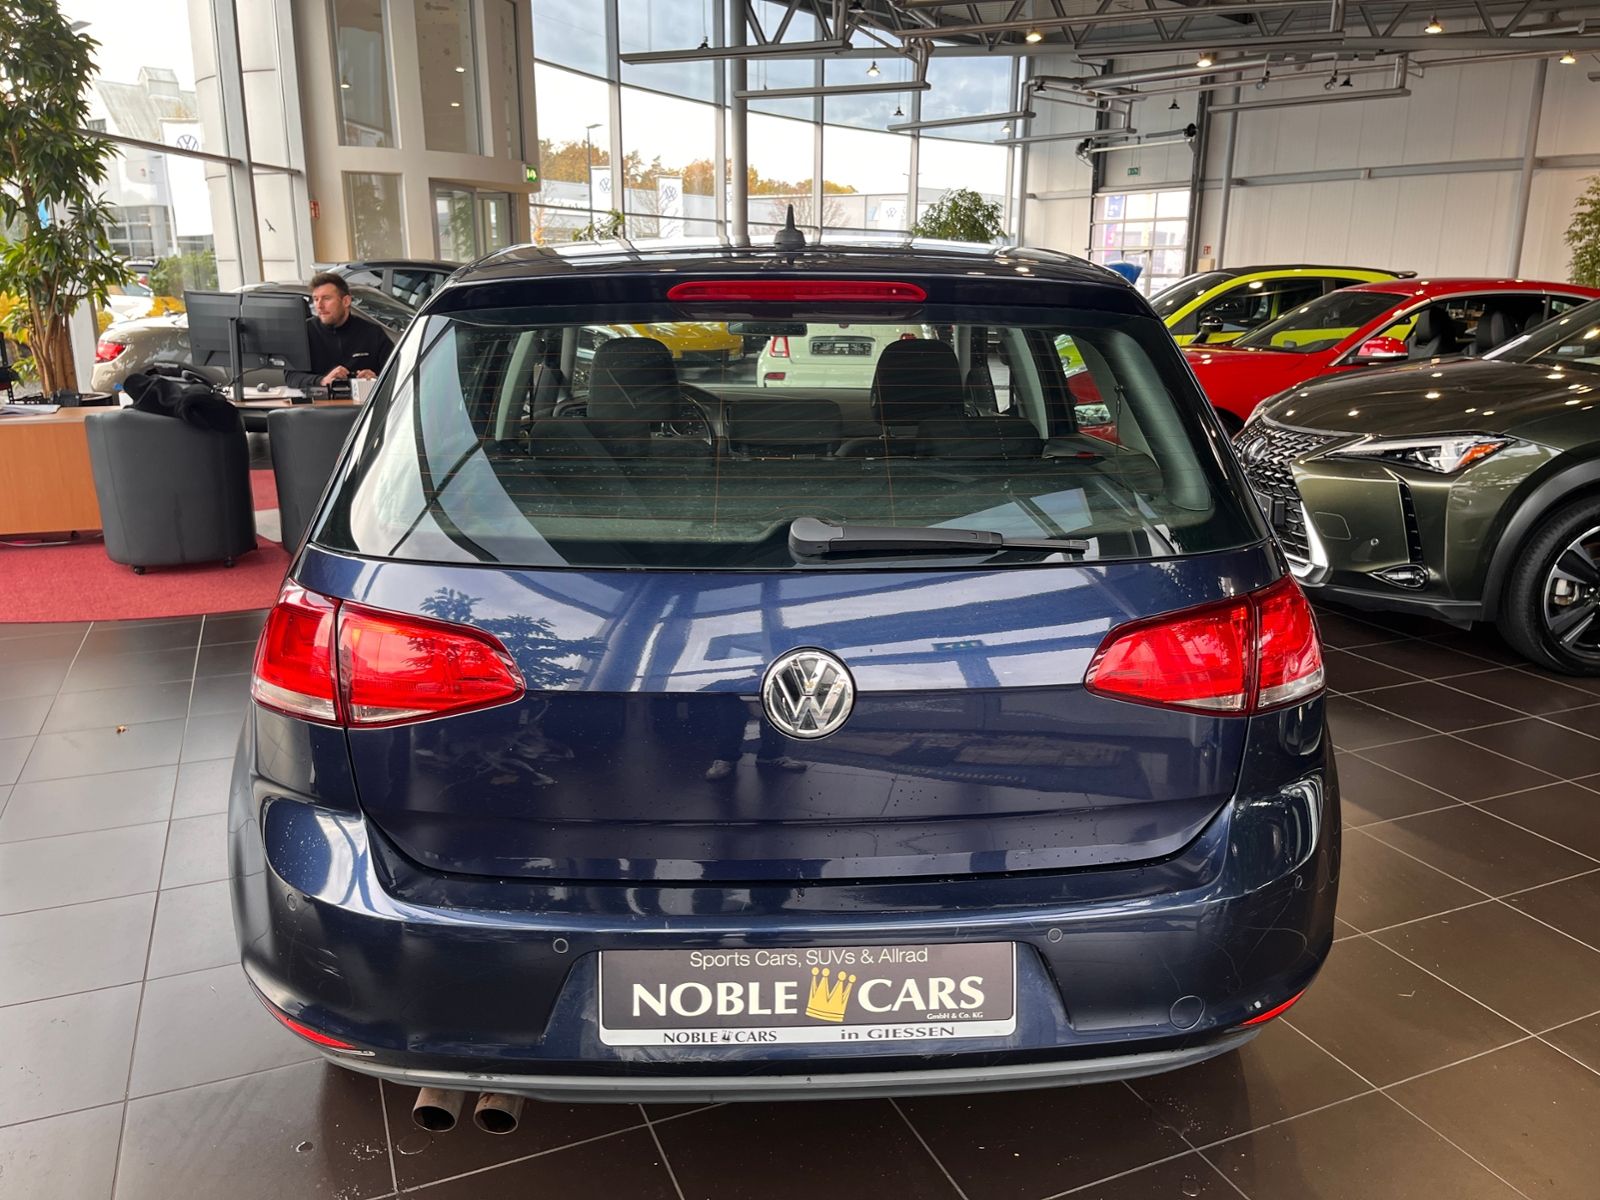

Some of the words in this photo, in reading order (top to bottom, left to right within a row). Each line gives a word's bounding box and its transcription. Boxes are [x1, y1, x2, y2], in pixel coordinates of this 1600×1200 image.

[689, 951, 750, 970] Sports
[755, 950, 802, 968] Cars,
[806, 949, 856, 966] SUVs
[860, 949, 874, 965] &
[878, 947, 928, 964] Allrad
[632, 981, 798, 1017] NOBLE
[857, 975, 985, 1013] CARS
[663, 1032, 718, 1044] NOBLE
[735, 1030, 778, 1043] CARS
[841, 1029, 859, 1040] in
[867, 1026, 955, 1040] GIESSEN
